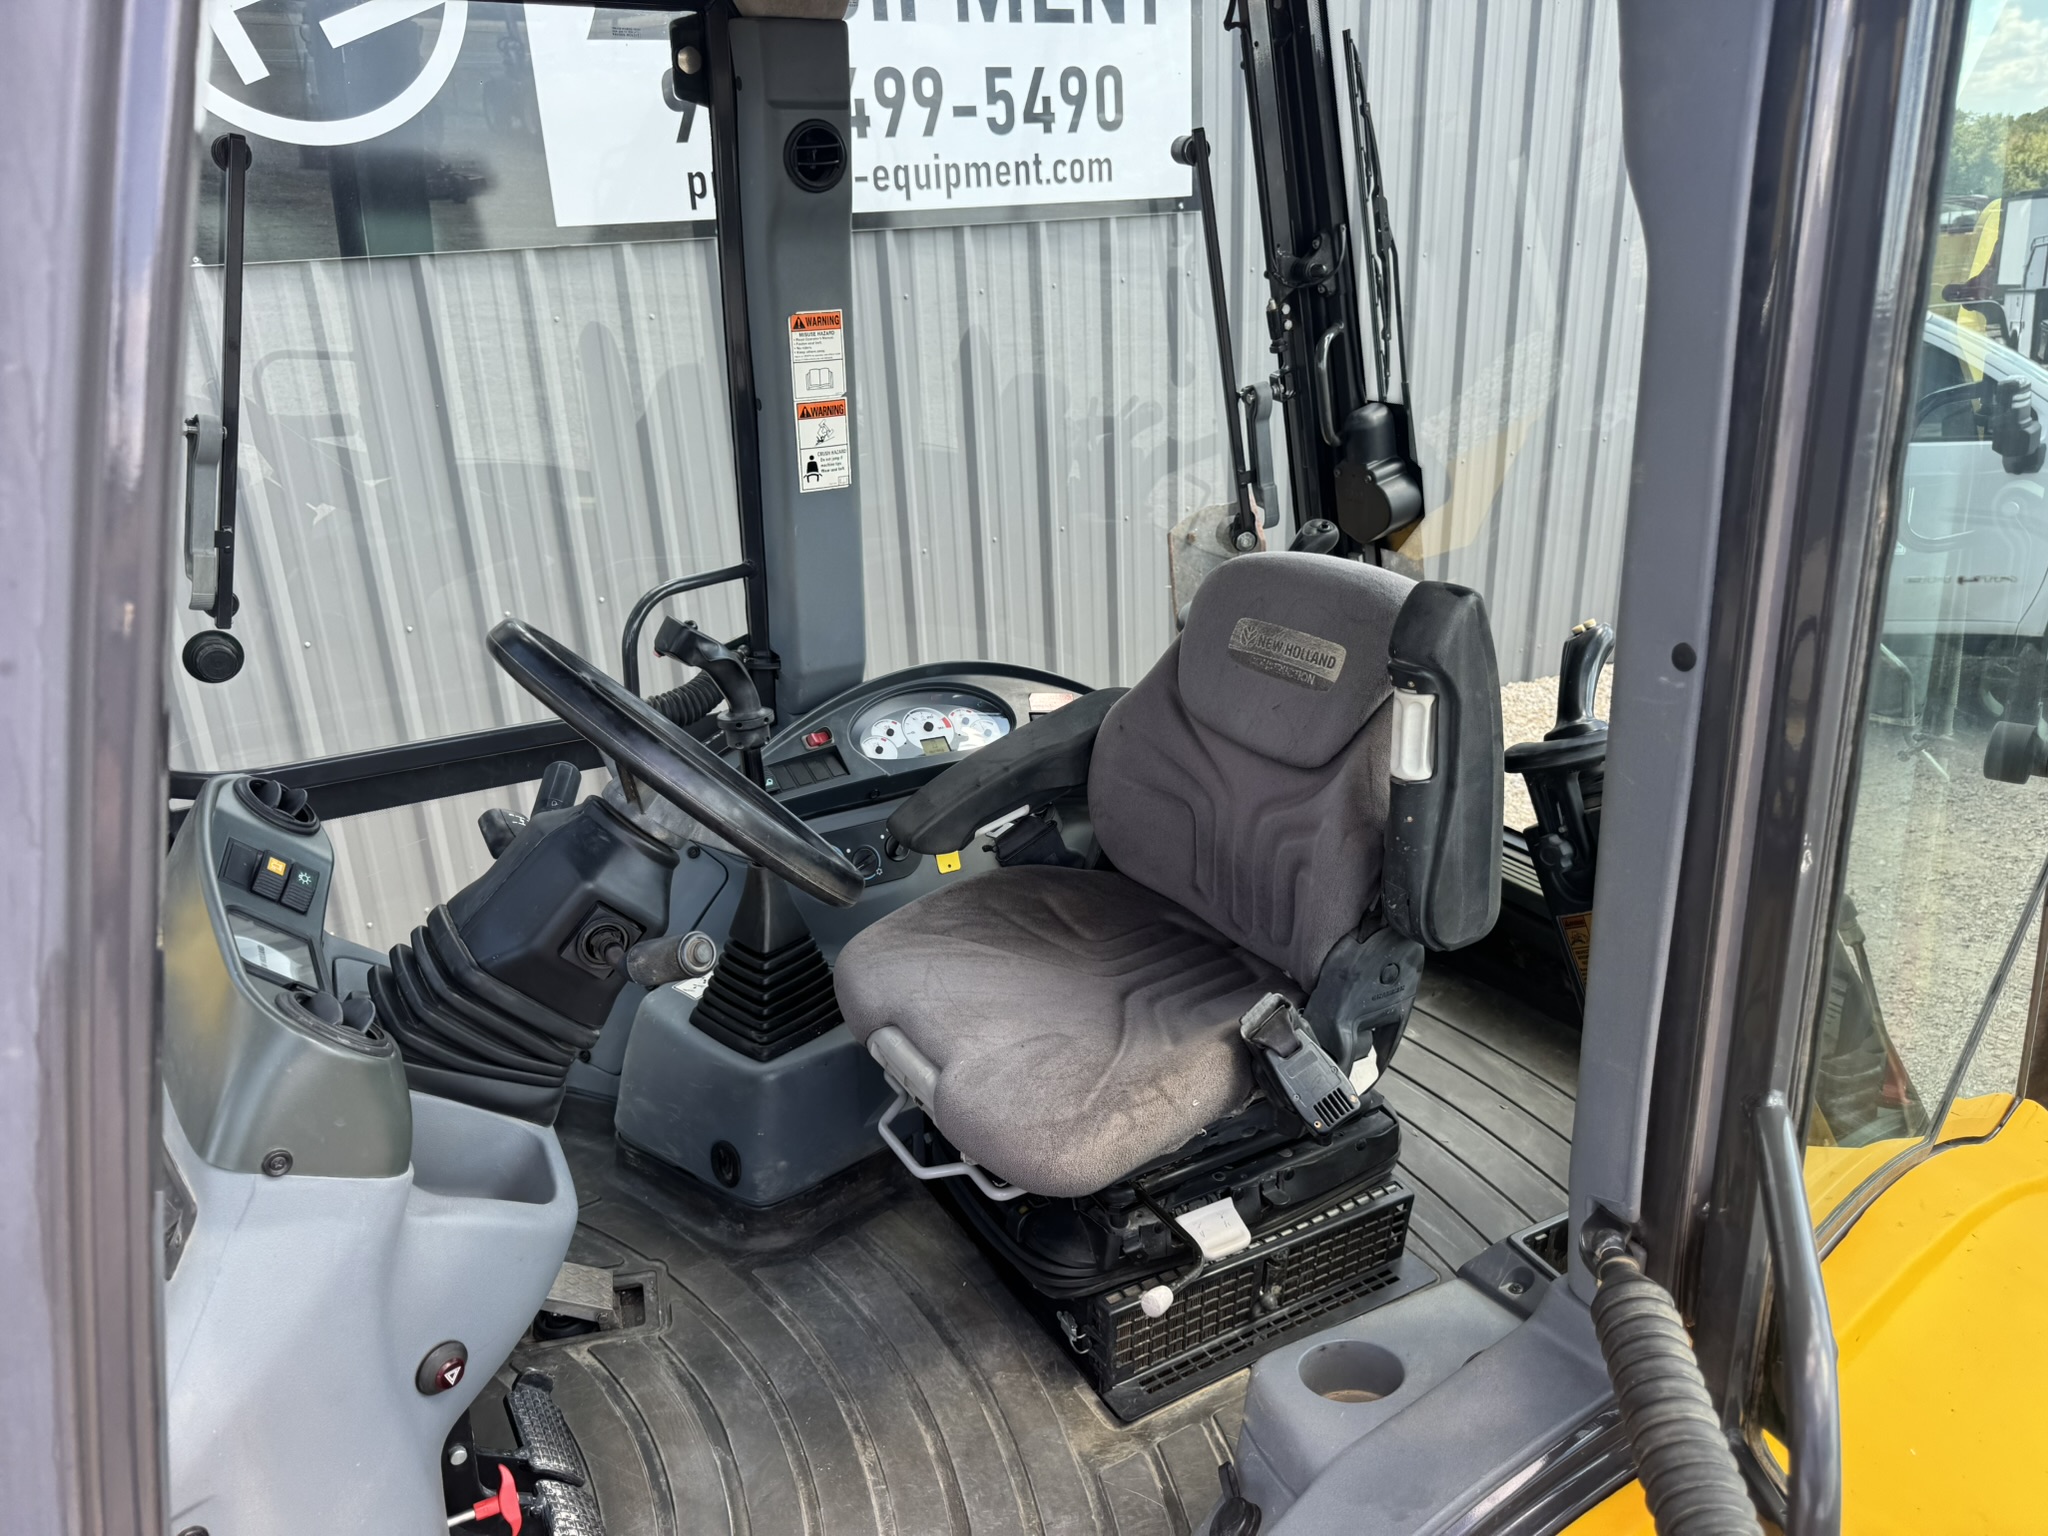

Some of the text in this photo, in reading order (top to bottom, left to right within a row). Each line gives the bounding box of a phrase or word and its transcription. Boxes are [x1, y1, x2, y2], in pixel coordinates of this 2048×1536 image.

[805, 314, 840, 328] WARNING
[810, 404, 844, 417] WARNING
[1257, 634, 1337, 669] NEW HOLLAND
